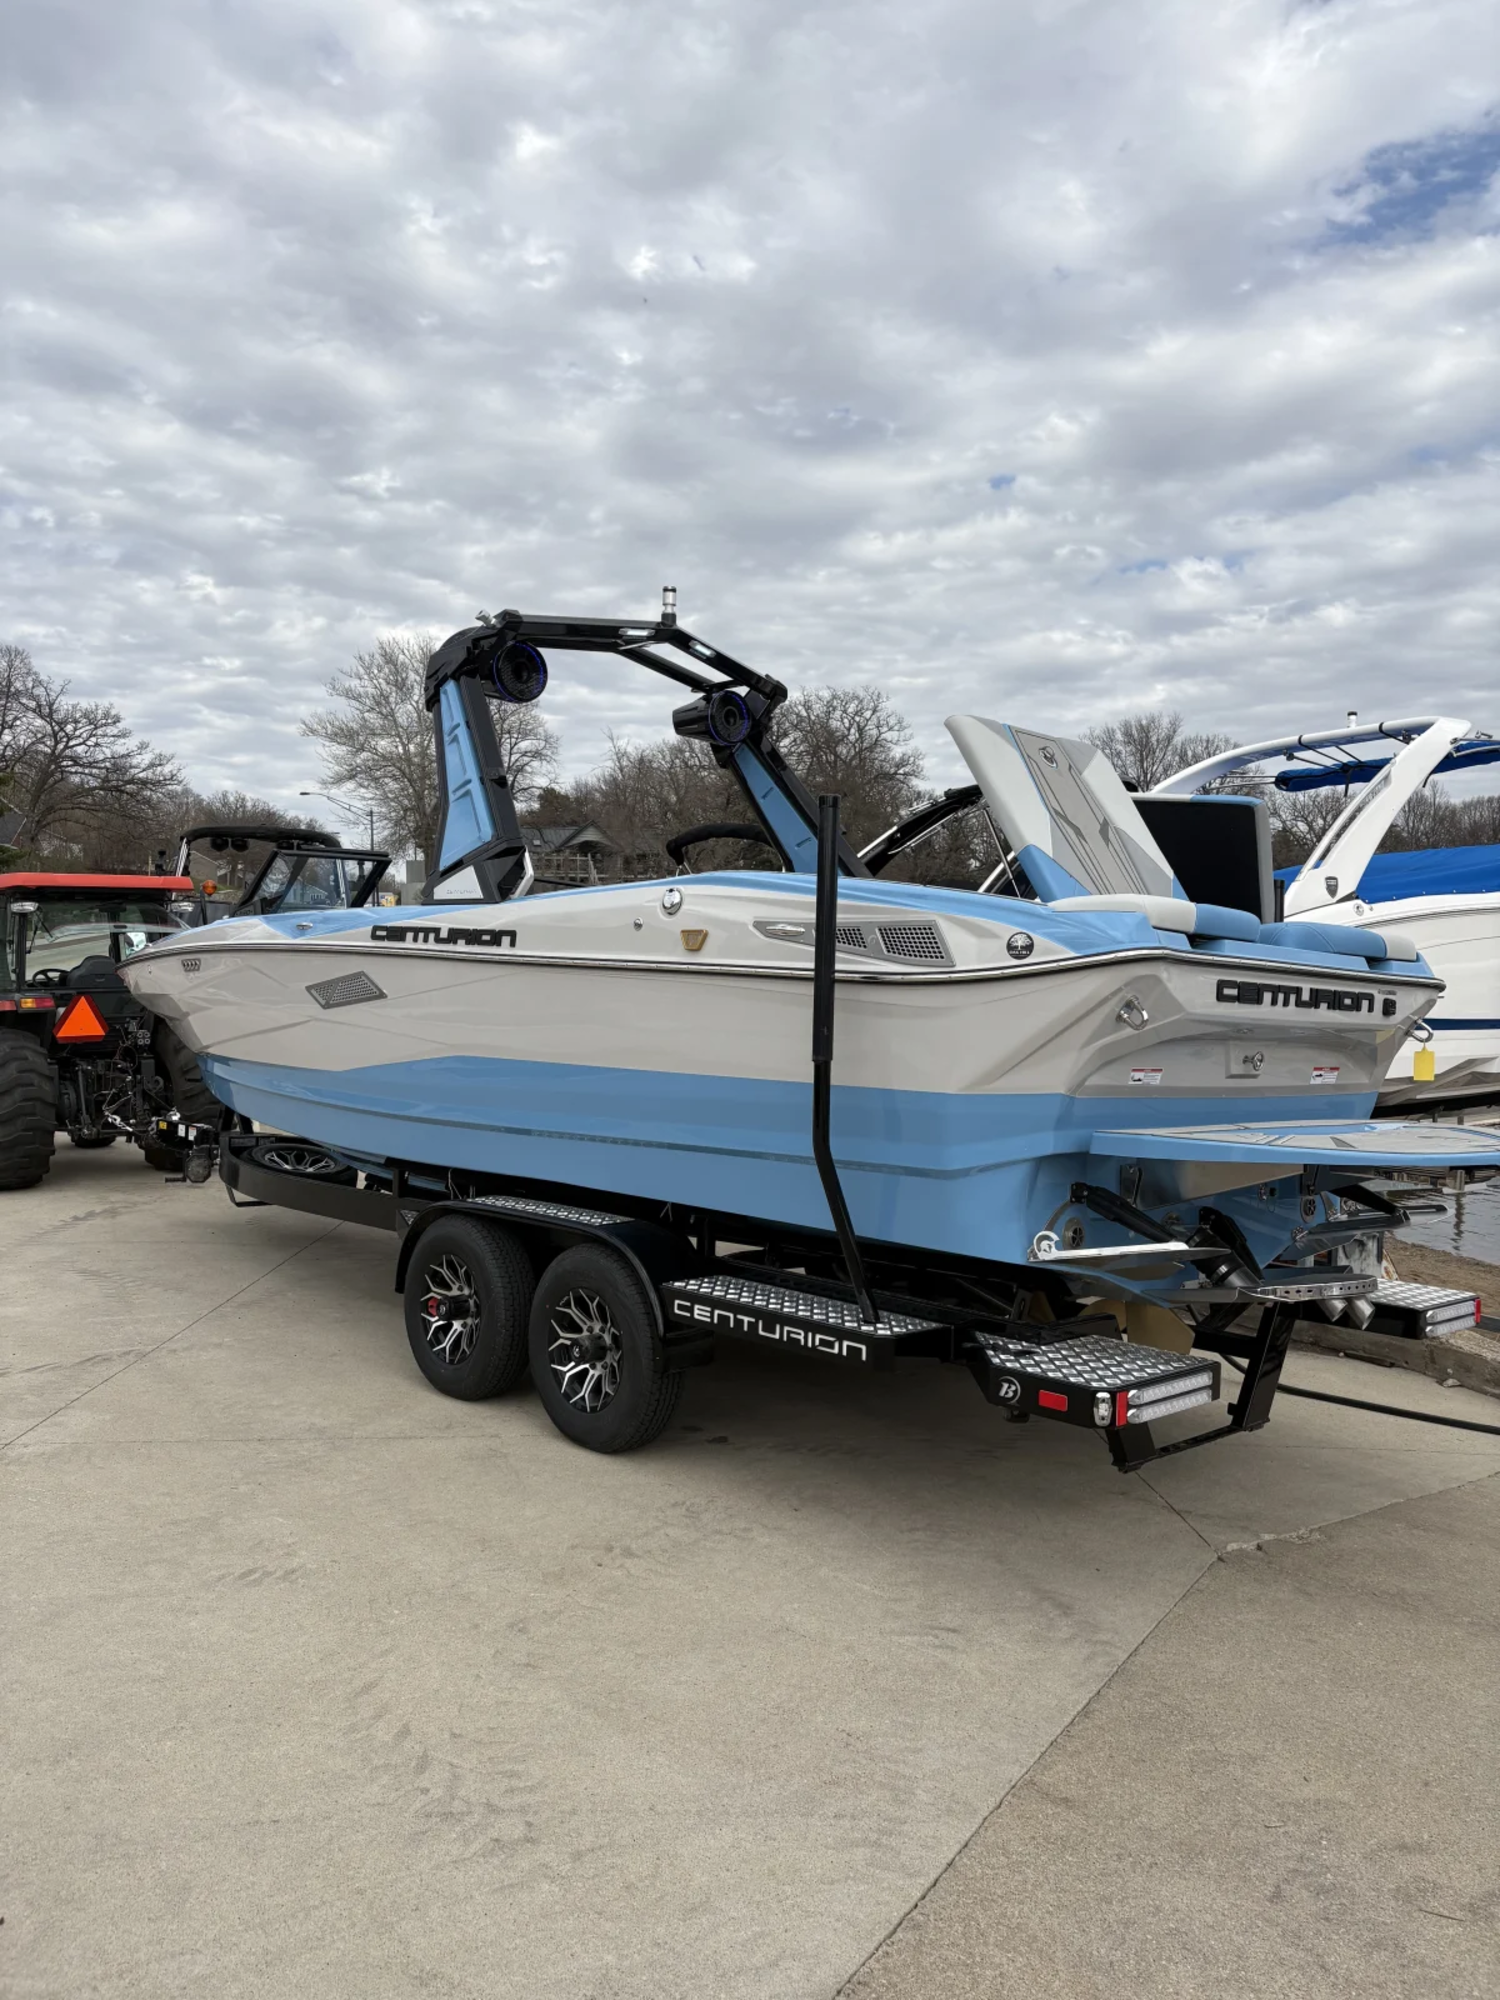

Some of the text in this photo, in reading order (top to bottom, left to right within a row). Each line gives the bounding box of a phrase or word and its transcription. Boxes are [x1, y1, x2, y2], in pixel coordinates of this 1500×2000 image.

[371, 925, 517, 948] CENTURION
[1216, 979, 1375, 1013] CENTURION
[674, 1299, 867, 1361] CENTURION
